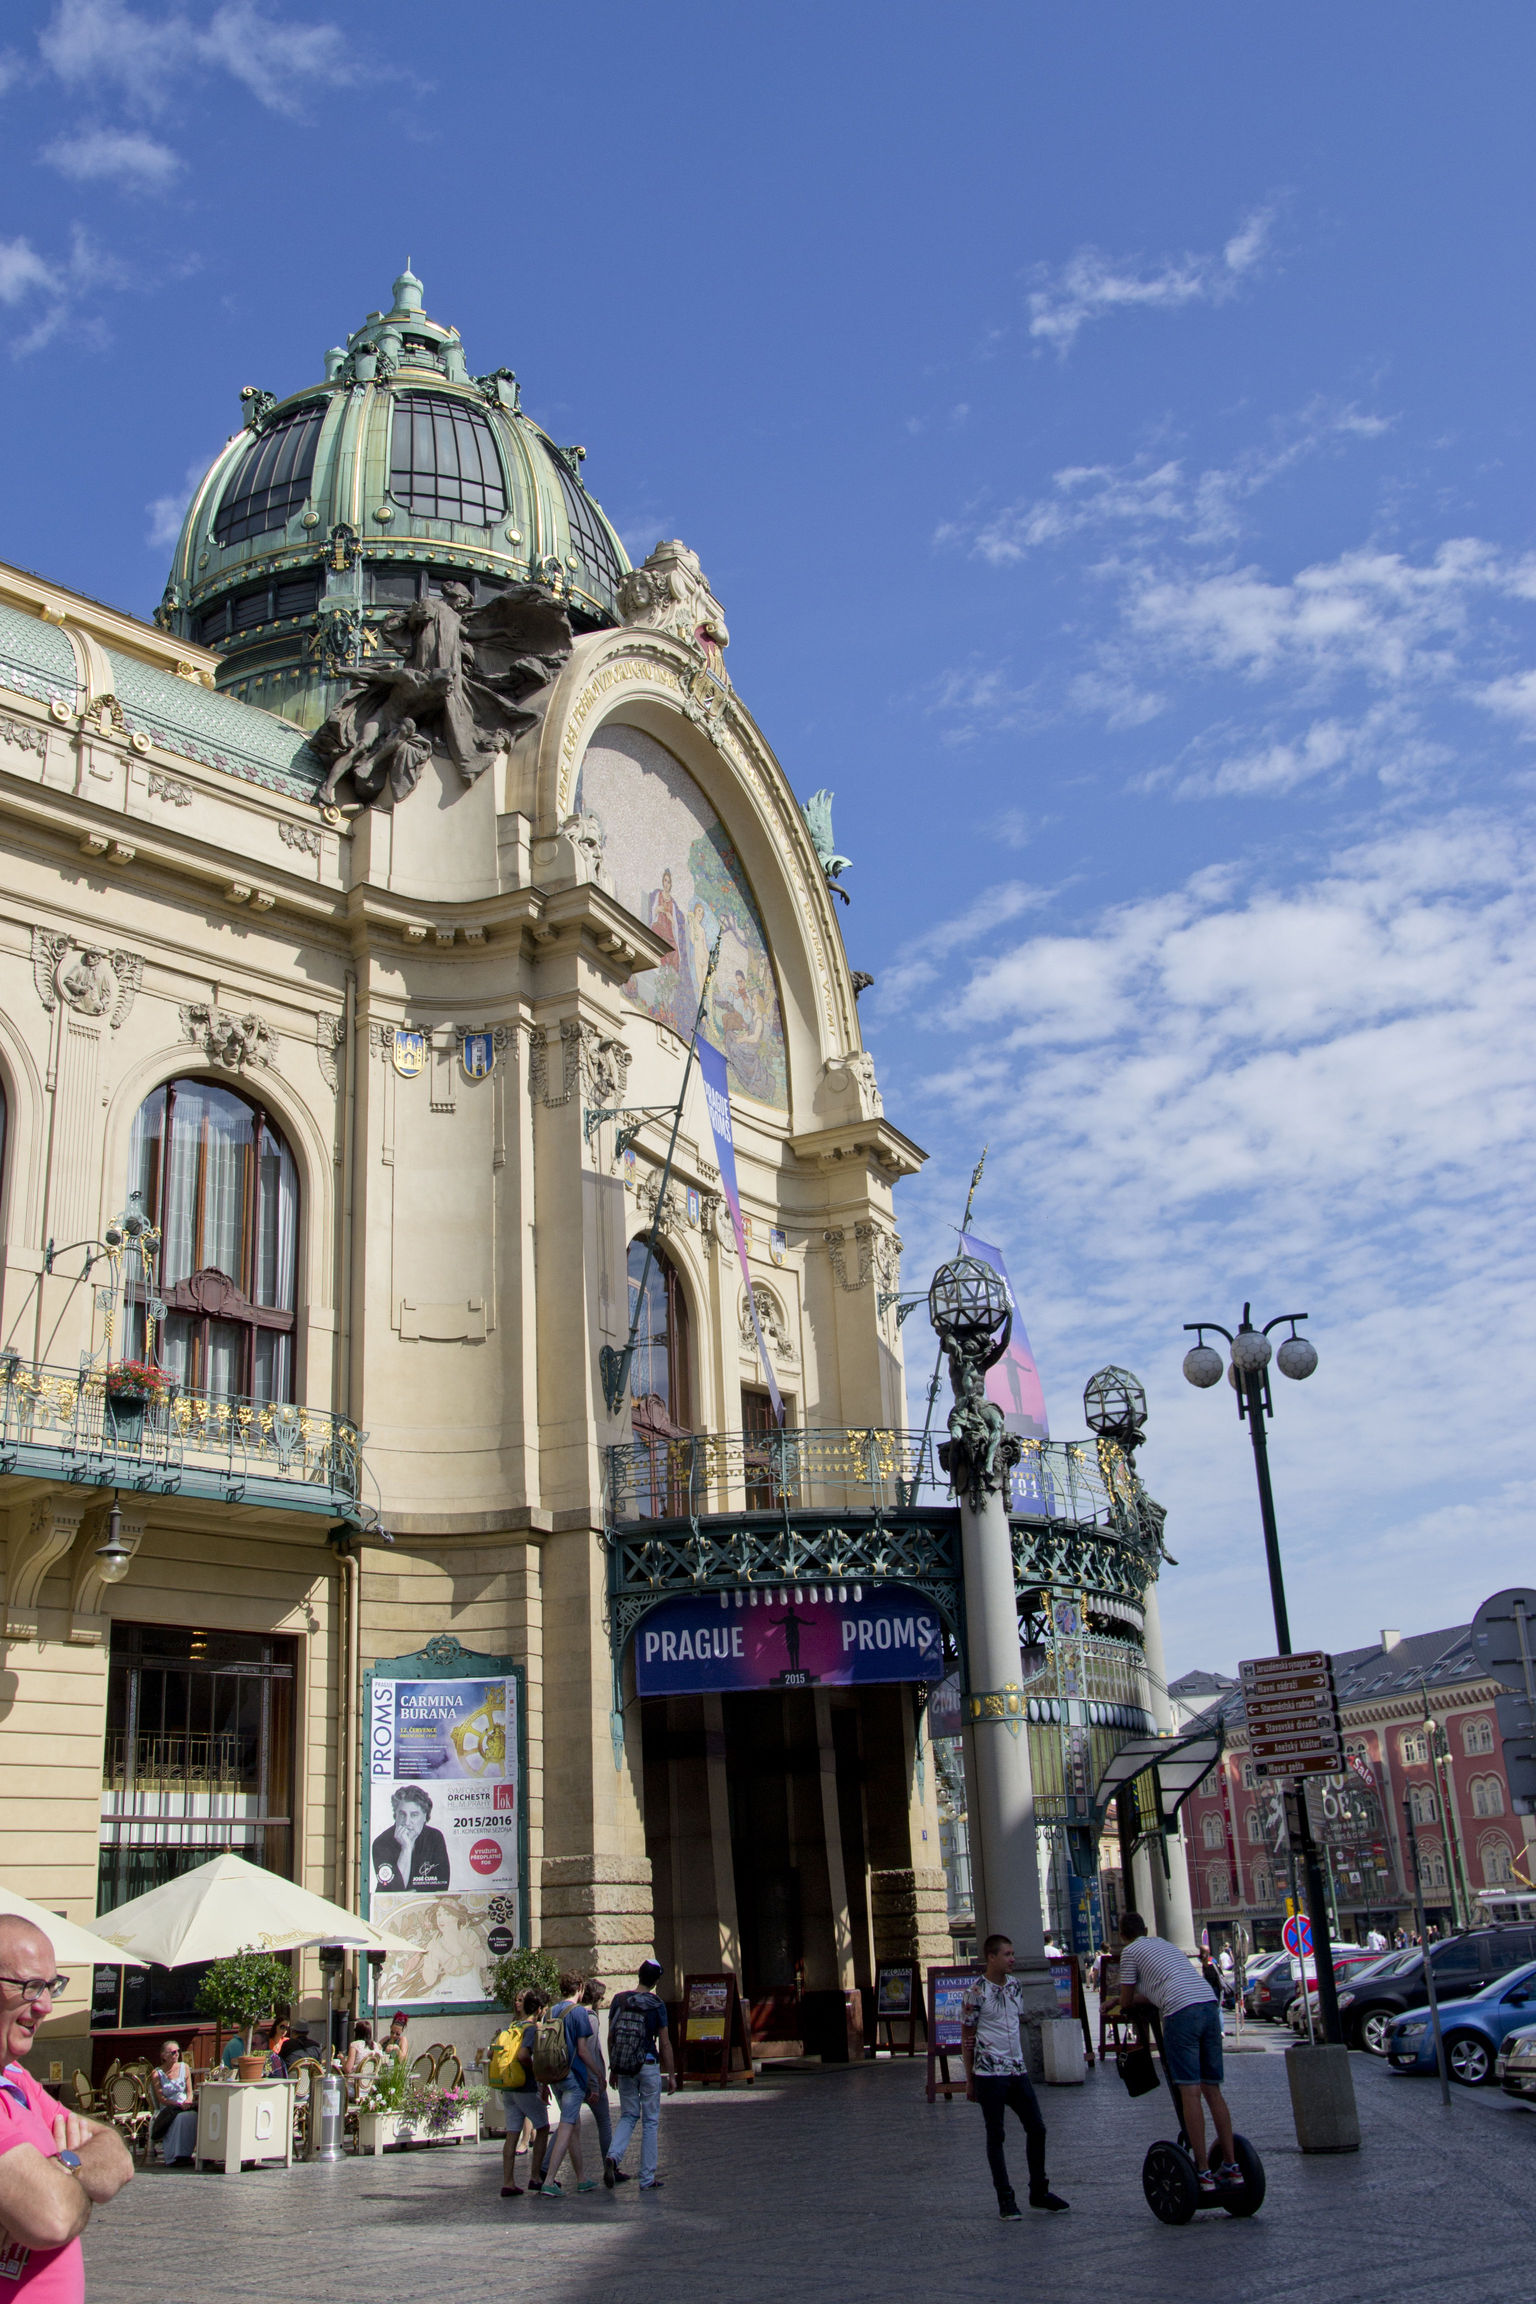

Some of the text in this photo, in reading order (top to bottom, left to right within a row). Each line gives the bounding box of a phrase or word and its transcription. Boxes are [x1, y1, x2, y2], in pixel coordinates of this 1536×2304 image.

[644, 1616, 933, 1663] PRAGUE PROMS
[784, 1673, 806, 1685] 2015
[400, 1695, 464, 1707] CARMINA
[400, 1707, 457, 1720] BURANA
[373, 1689, 393, 1775] PROMS
[1353, 1757, 1373, 1785] Sale
[447, 1793, 491, 1801] ORCHESTR
[453, 1816, 512, 1828] 2015/2016
